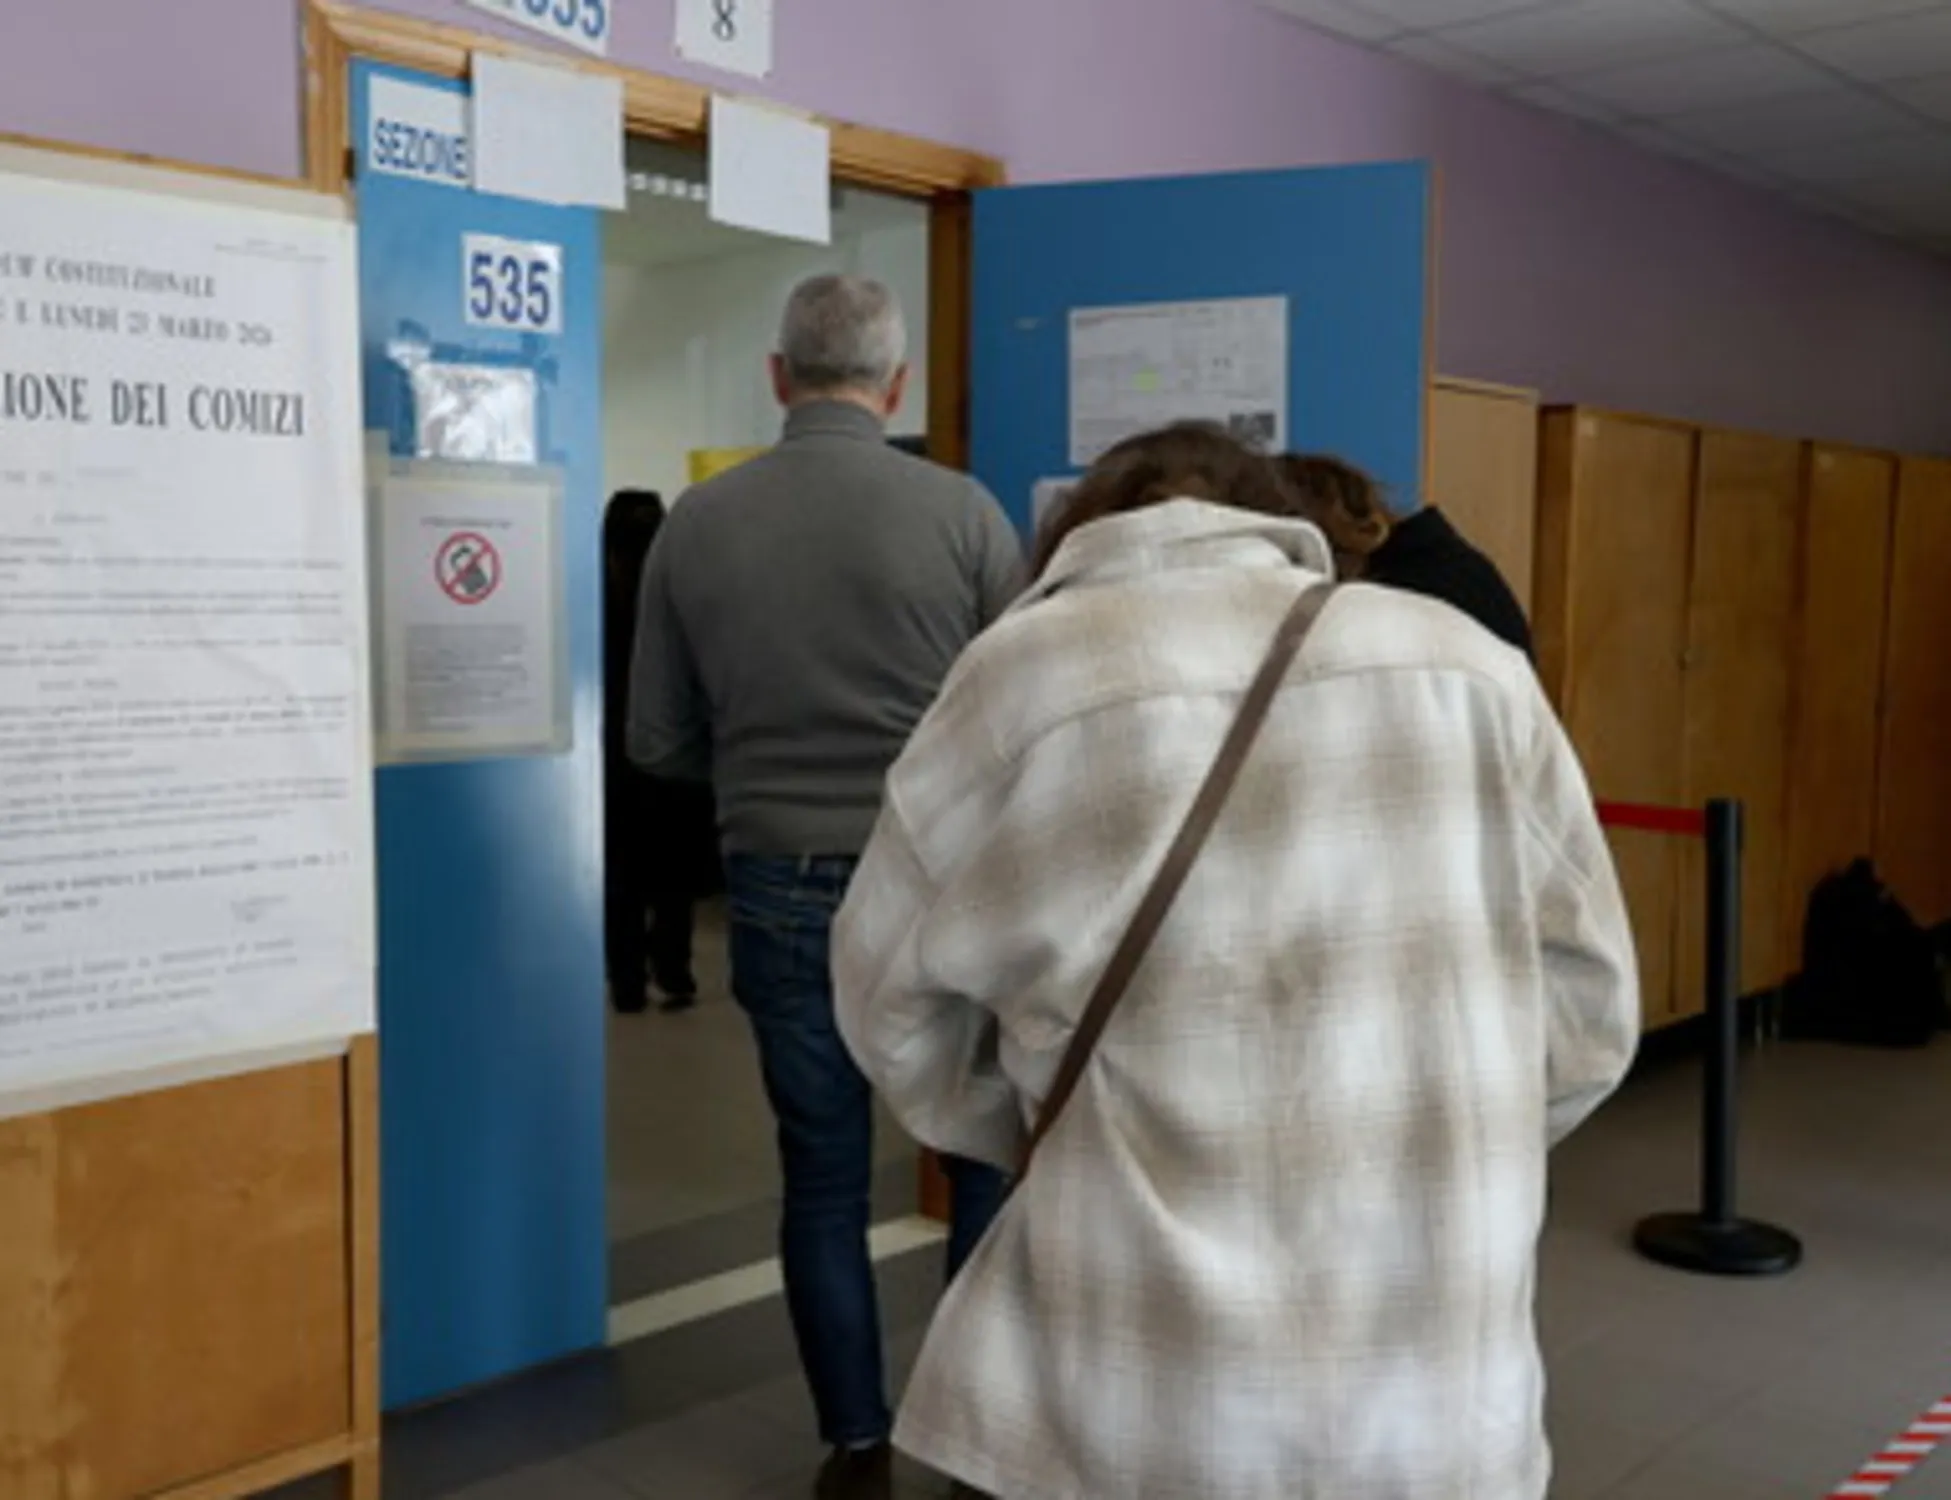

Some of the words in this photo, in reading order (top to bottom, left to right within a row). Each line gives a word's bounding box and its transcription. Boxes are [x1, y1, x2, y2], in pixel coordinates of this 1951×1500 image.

[373, 116, 469, 179] SEZIONE
[470, 252, 550, 326] 535
[157, 313, 230, 343] MARZO
[2, 371, 90, 425] IONE
[110, 378, 167, 428] DEI
[187, 383, 305, 437] COMIZI
